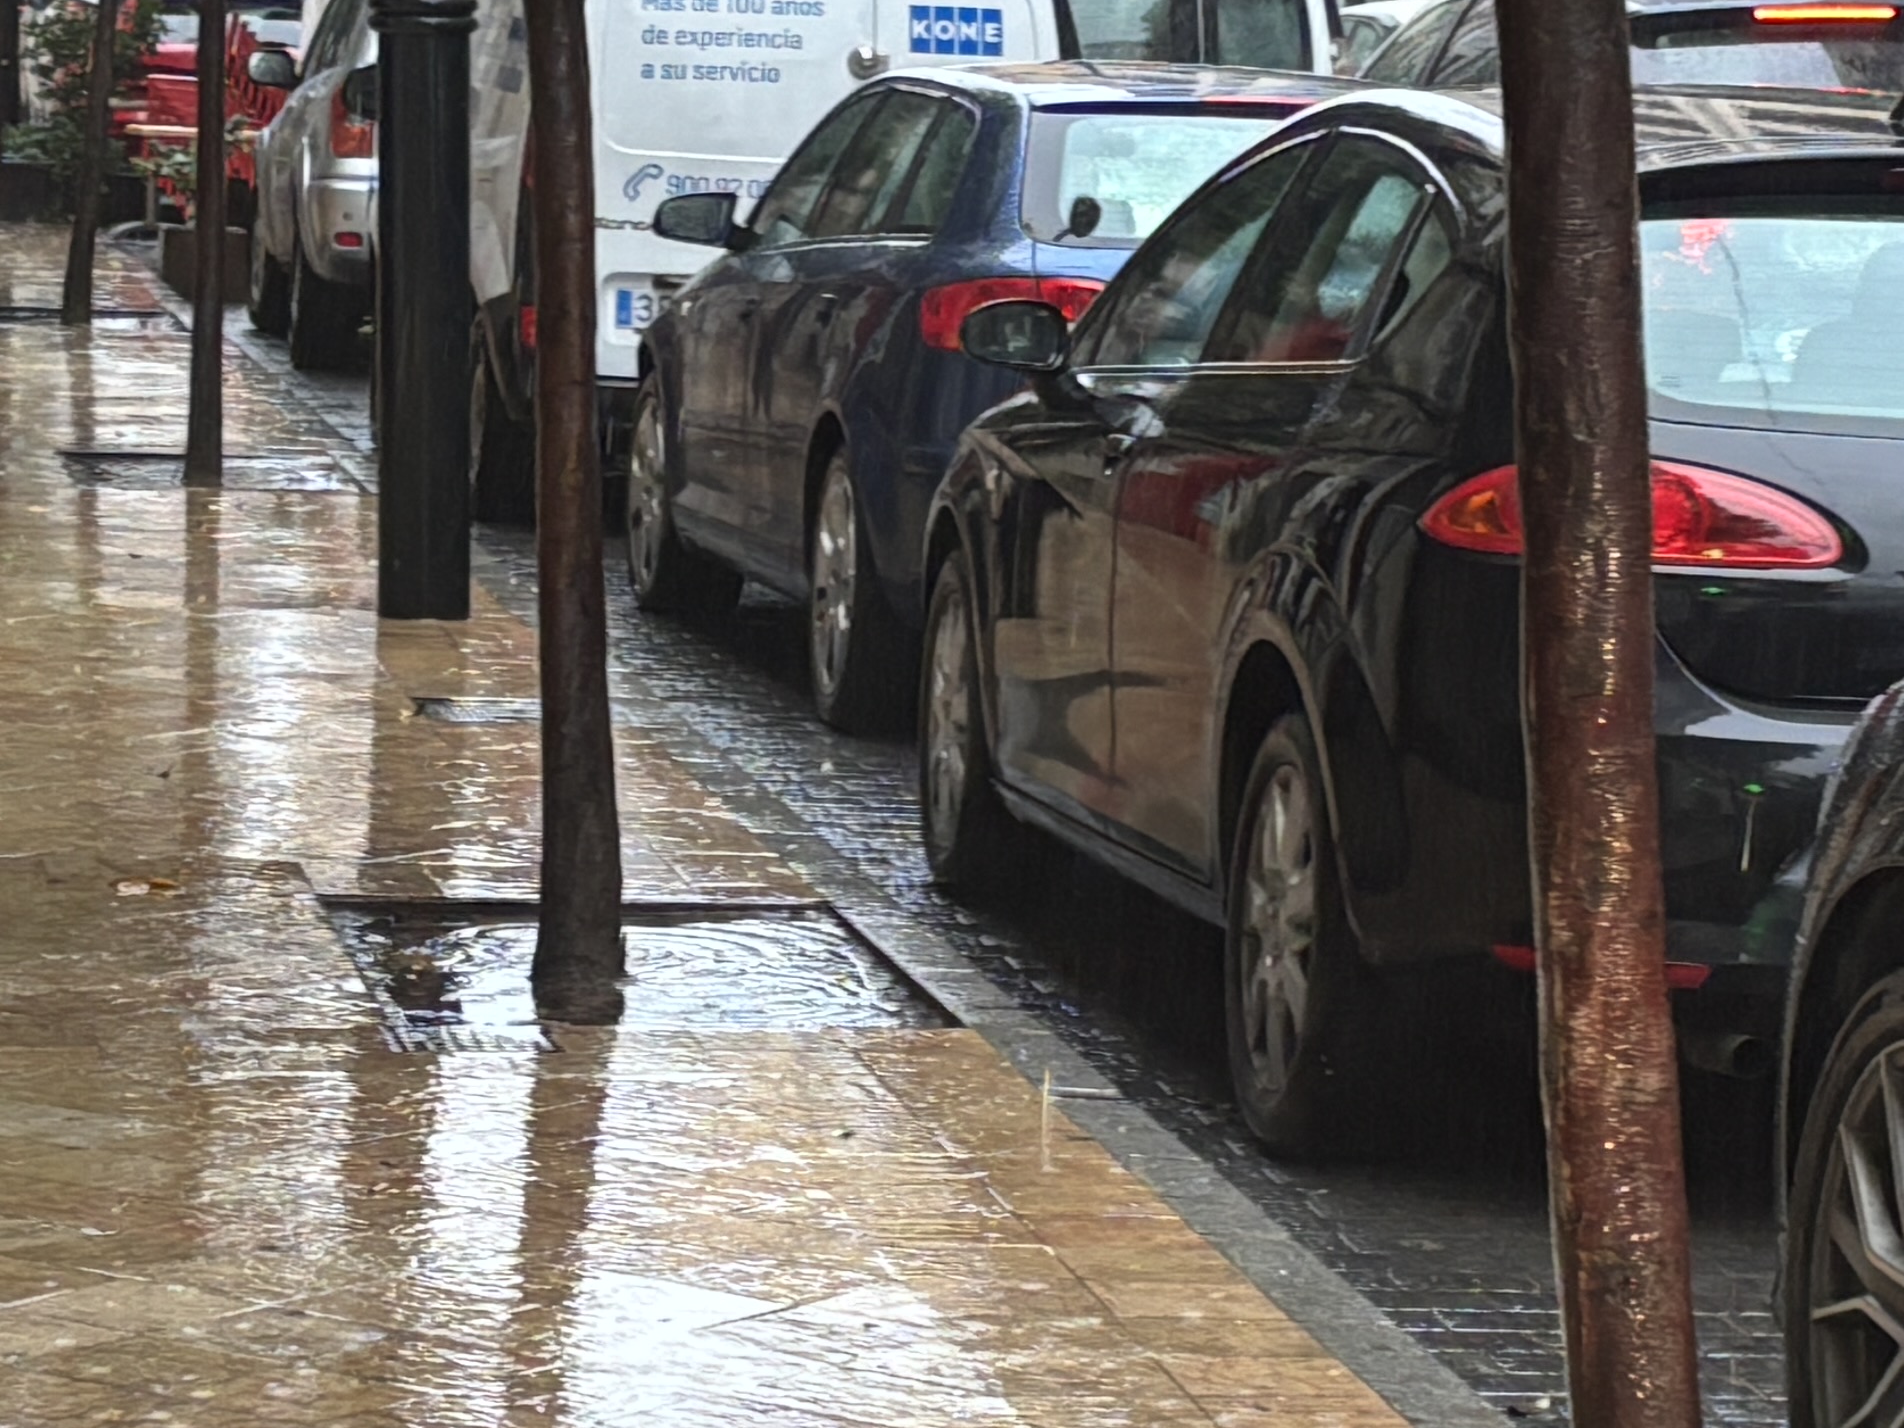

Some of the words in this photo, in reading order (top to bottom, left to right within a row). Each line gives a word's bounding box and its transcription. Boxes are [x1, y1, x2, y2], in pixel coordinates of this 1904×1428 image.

[641, 24, 669, 45] de
[674, 27, 804, 51] experiencia
[911, 18, 1003, 44] KONE
[640, 62, 656, 80] a
[660, 63, 688, 80] su
[692, 61, 781, 83] servicio
